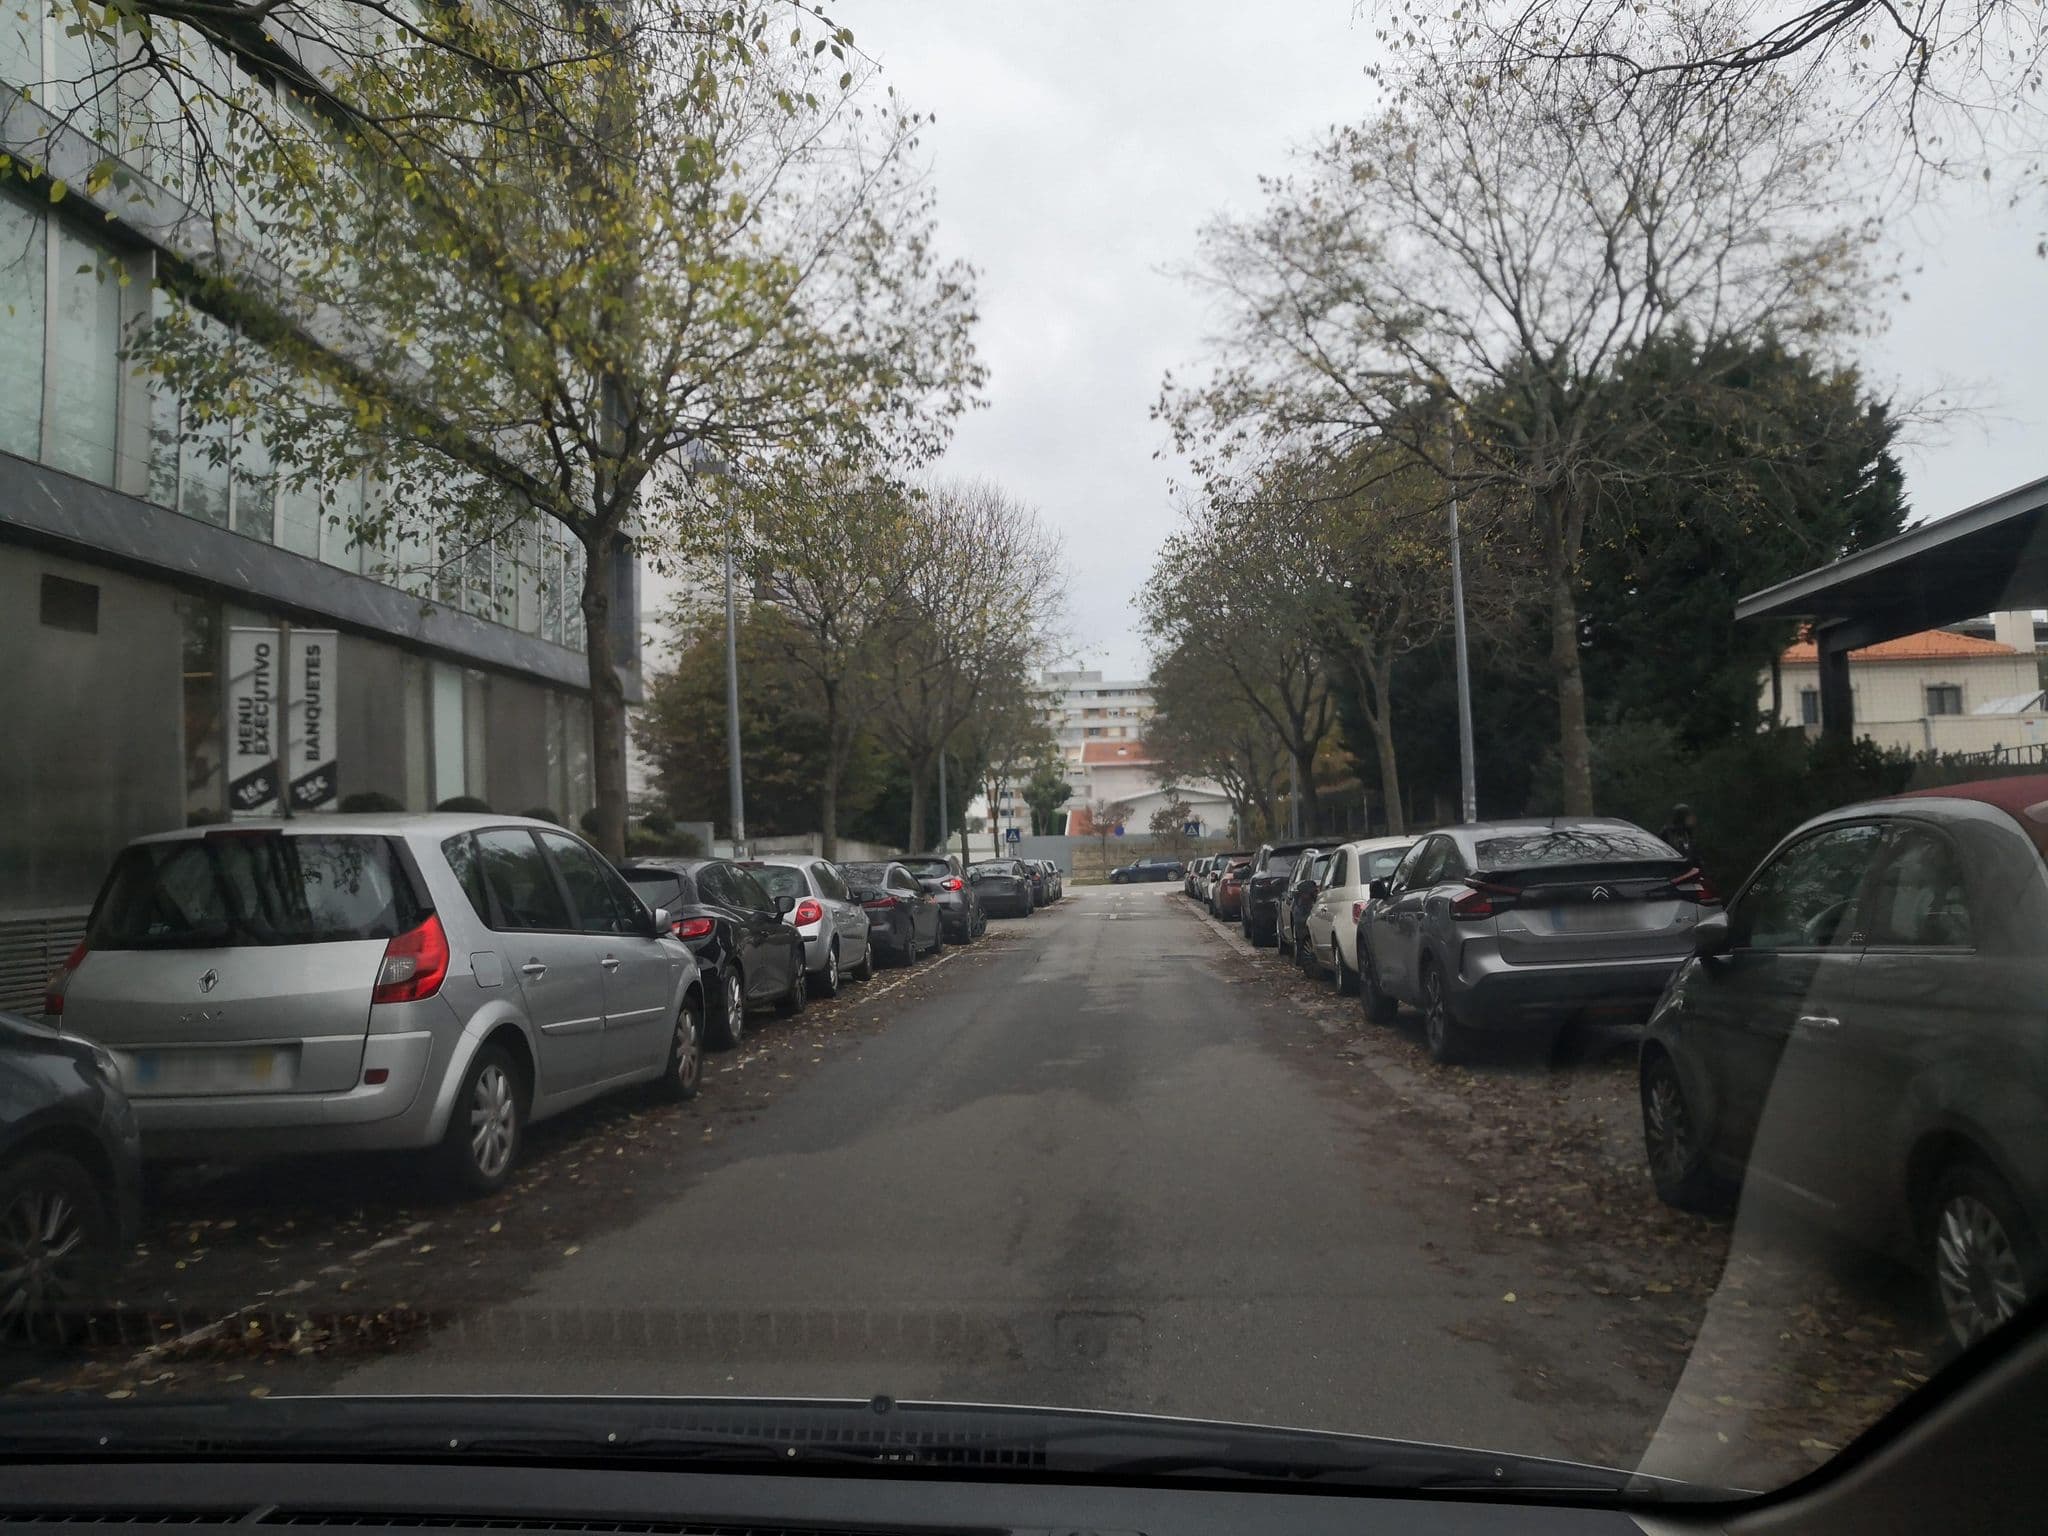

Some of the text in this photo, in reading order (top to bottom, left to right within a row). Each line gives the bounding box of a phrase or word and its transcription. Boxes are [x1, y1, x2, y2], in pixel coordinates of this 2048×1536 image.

[237, 697, 252, 755] MENU
[255, 643, 271, 756] EXECUTIVO
[305, 644, 321, 761] BANQUETES
